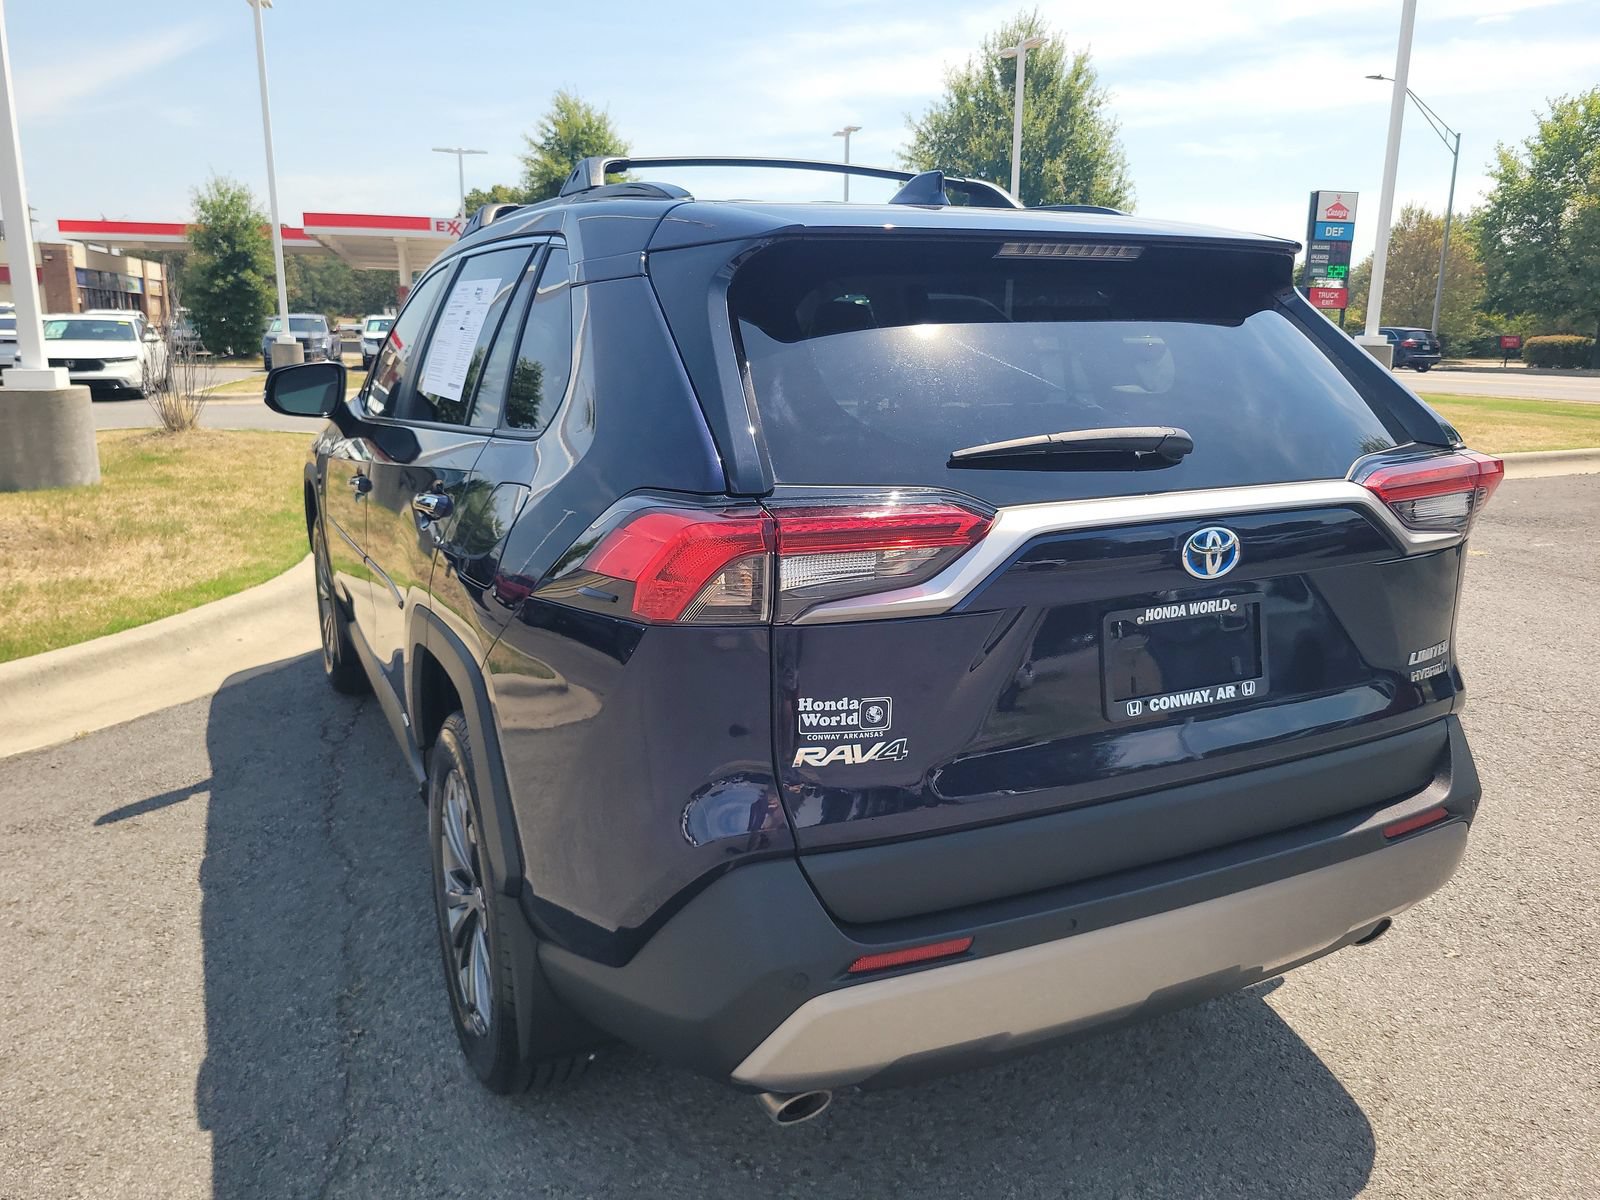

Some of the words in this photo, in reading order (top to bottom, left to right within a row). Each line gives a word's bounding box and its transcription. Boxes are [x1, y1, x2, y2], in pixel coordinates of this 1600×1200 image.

[436, 220, 463, 236] EXX
[1325, 226, 1344, 236] DEF
[1145, 604, 1186, 622] HONDA
[1189, 599, 1230, 615] WORLD
[798, 697, 859, 711] Honda
[1149, 690, 1214, 712] CONWAY,
[1216, 685, 1236, 699] AR
[801, 712, 859, 727] World
[843, 731, 884, 739] ARKANSAS
[792, 738, 908, 768] RAV4
